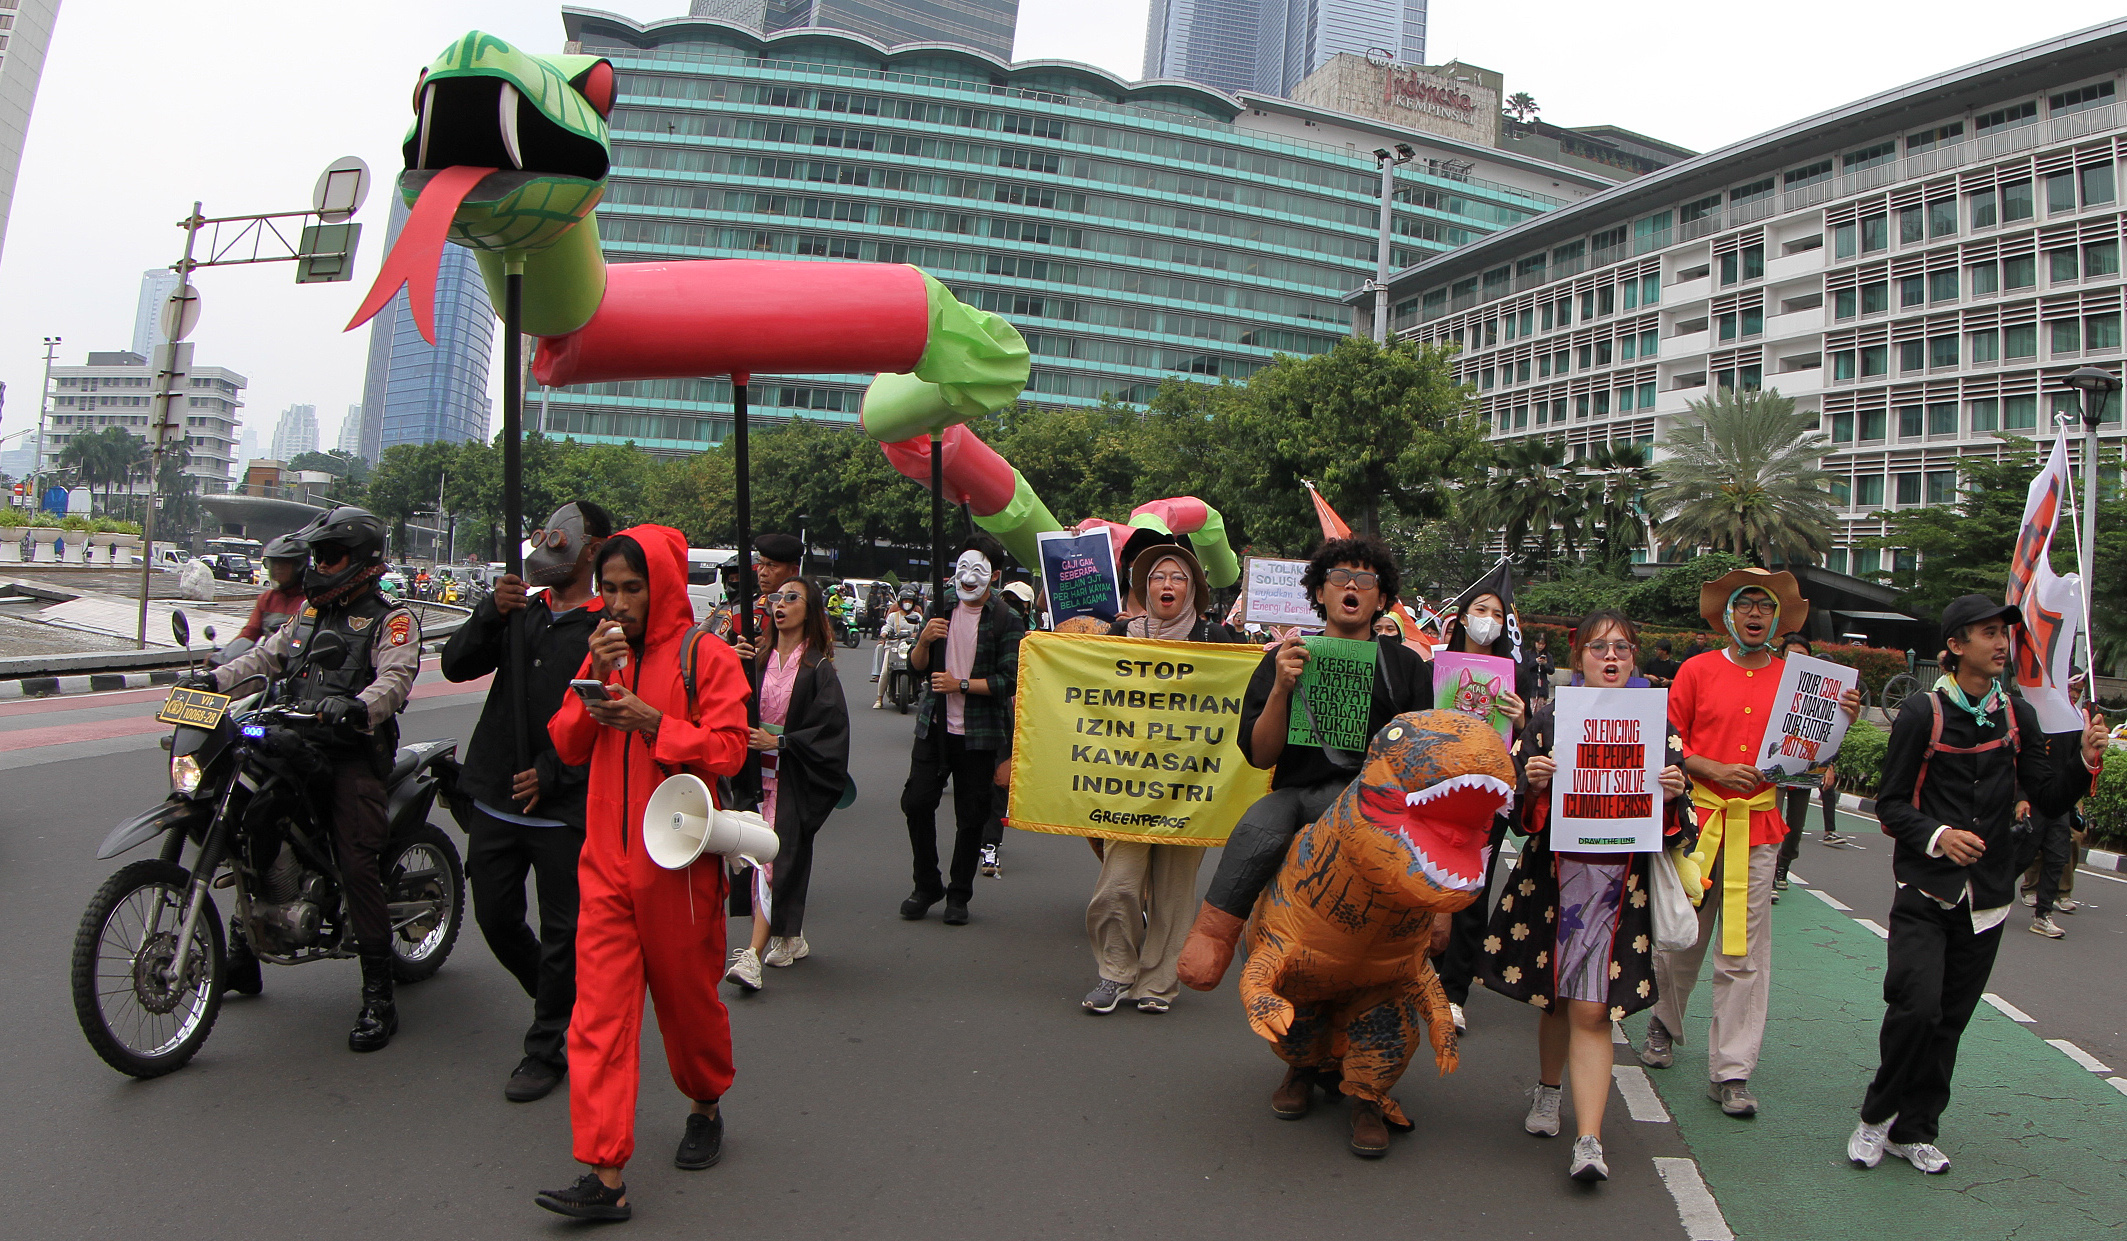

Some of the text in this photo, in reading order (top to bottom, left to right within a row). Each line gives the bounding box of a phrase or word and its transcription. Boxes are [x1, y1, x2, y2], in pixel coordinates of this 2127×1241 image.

[1384, 67, 1477, 113] Indonesia
[1396, 95, 1474, 124] KEMPINSKI
[1061, 558, 1094, 570] GAJI GAK
[1268, 564, 1304, 575] TOLAK
[1060, 574, 1101, 591] BELAIN 3JT
[1256, 575, 1297, 587] SOLUSI
[1053, 583, 1111, 601] PER HARI KAYAK
[1060, 593, 1108, 610] BELA AGAMA
[1252, 600, 1280, 615] Energi
[1115, 659, 1194, 680] STOP
[1316, 657, 1374, 677] KESELA
[1319, 672, 1373, 691] MATAN
[1466, 684, 1487, 695] ACAB
[1797, 670, 1842, 701] YOUR COAL
[1065, 686, 1241, 715] PEMBERIAN
[1309, 685, 1371, 706] RAKYAT
[183, 708, 217, 724] 10068-28
[1307, 700, 1370, 720] ADALAH
[1790, 692, 1837, 722] IS MAKING
[1076, 717, 1224, 745] IZIN PLTU
[1315, 715, 1366, 735] HUKUM
[1583, 719, 1640, 743] SILENCING
[1782, 713, 1834, 743] OUR FUTURE
[1580, 744, 1643, 768] THE PEOPLE
[1780, 735, 1801, 758] NOT
[1071, 744, 1221, 774] KAWASAN
[1072, 775, 1213, 802] INDUSTRI
[1572, 769, 1646, 793] WON'T SOLVE
[1566, 793, 1651, 818] CLIMATE CRISIS
[1089, 808, 1190, 829] GREENPEACE
[1578, 836, 1635, 845] DRAW THE LINE
